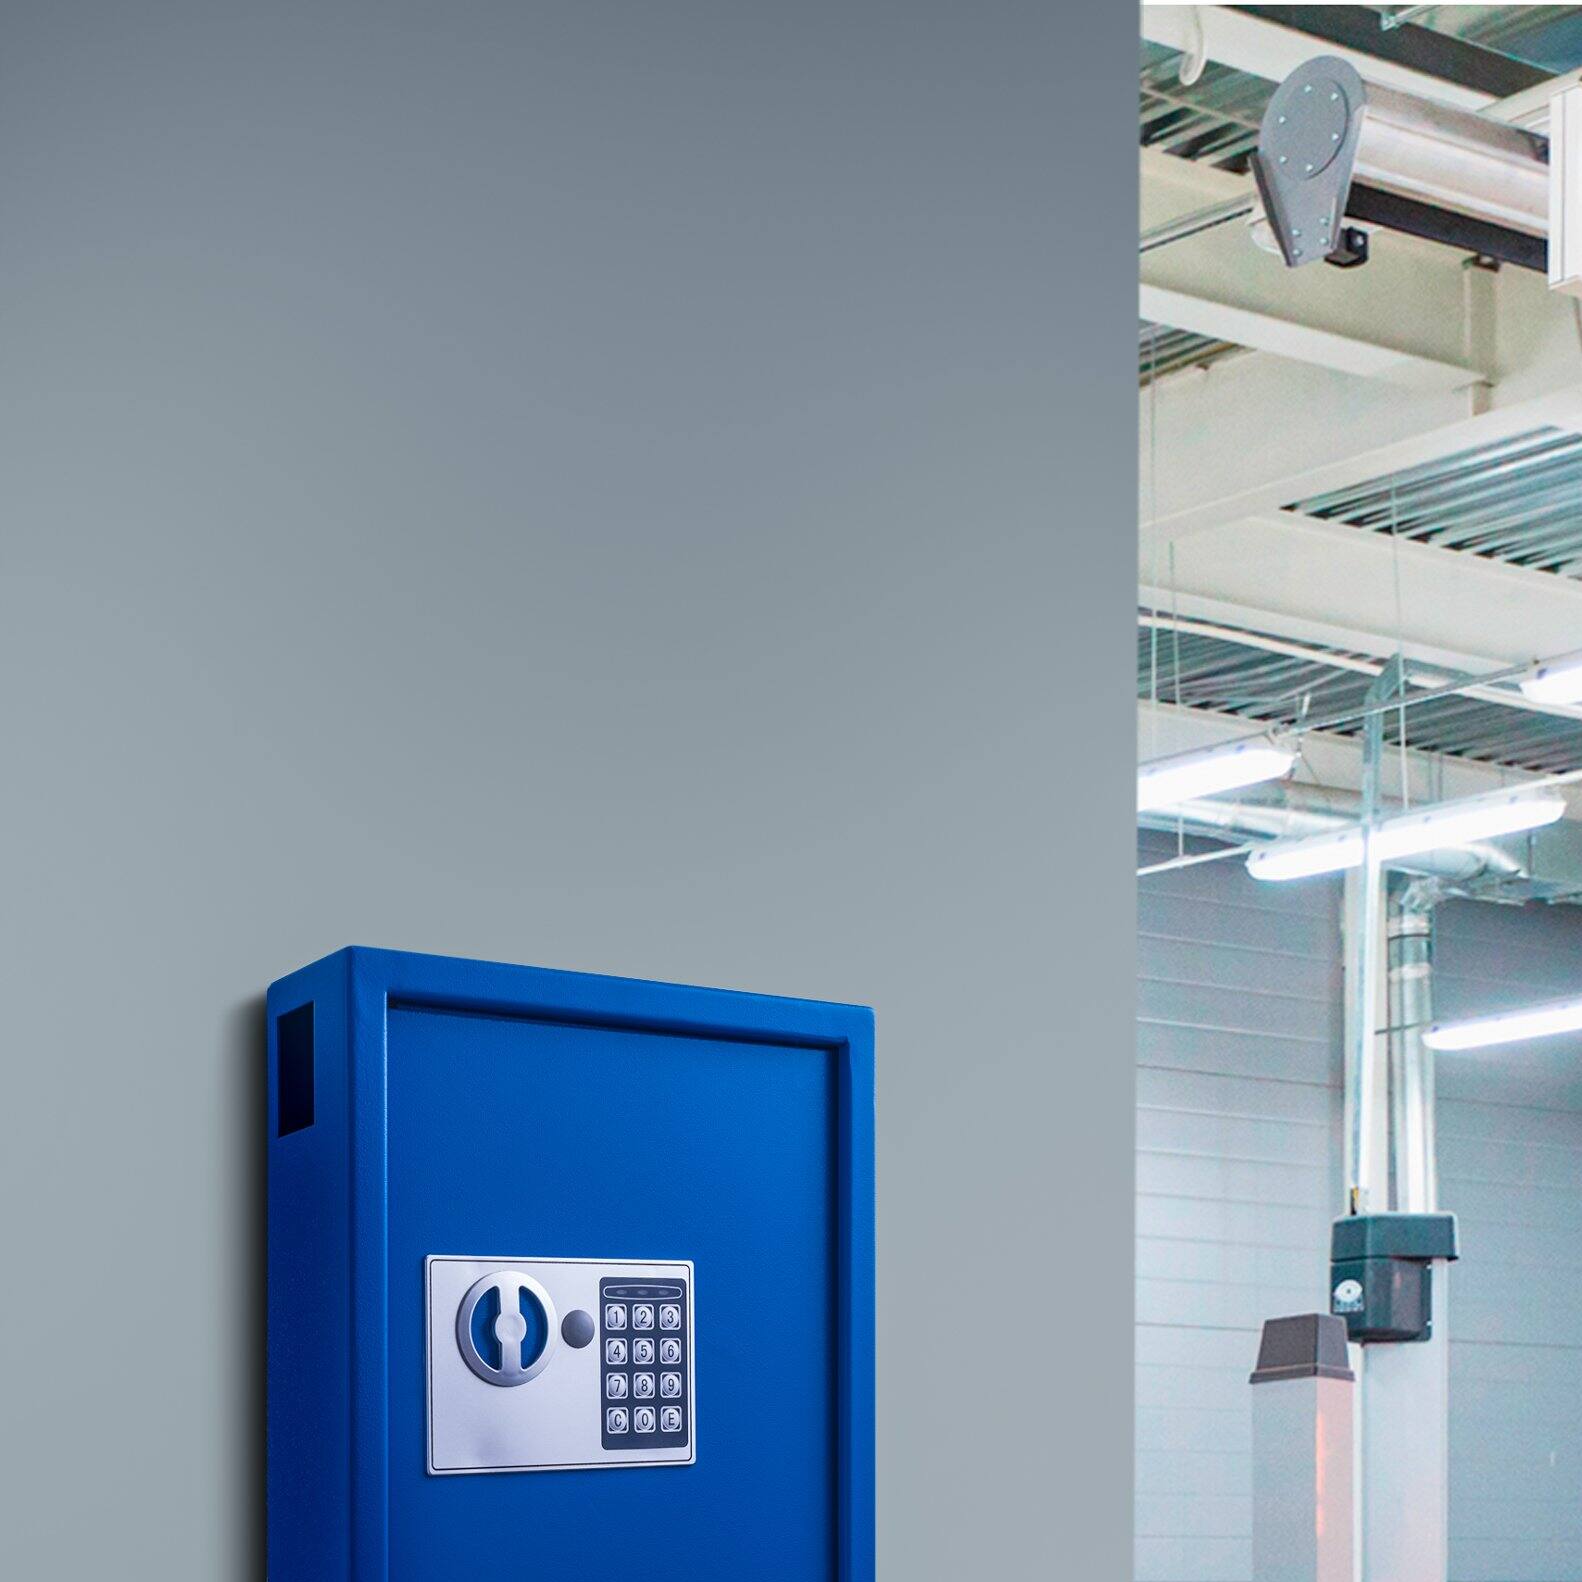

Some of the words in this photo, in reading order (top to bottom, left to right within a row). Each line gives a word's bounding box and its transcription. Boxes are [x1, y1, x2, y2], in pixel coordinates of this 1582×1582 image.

[614, 1311, 619, 1324] 1
[640, 1310, 647, 1324] 2
[667, 1310, 674, 1324] 3
[613, 1345, 621, 1359] 4
[640, 1344, 648, 1358] 5
[667, 1344, 675, 1358] 6
[614, 1379, 621, 1393] 7
[641, 1378, 648, 1392] 8
[668, 1378, 675, 1392] 9
[614, 1413, 622, 1427] C
[641, 1413, 649, 1427] 0
[668, 1412, 675, 1426] E
